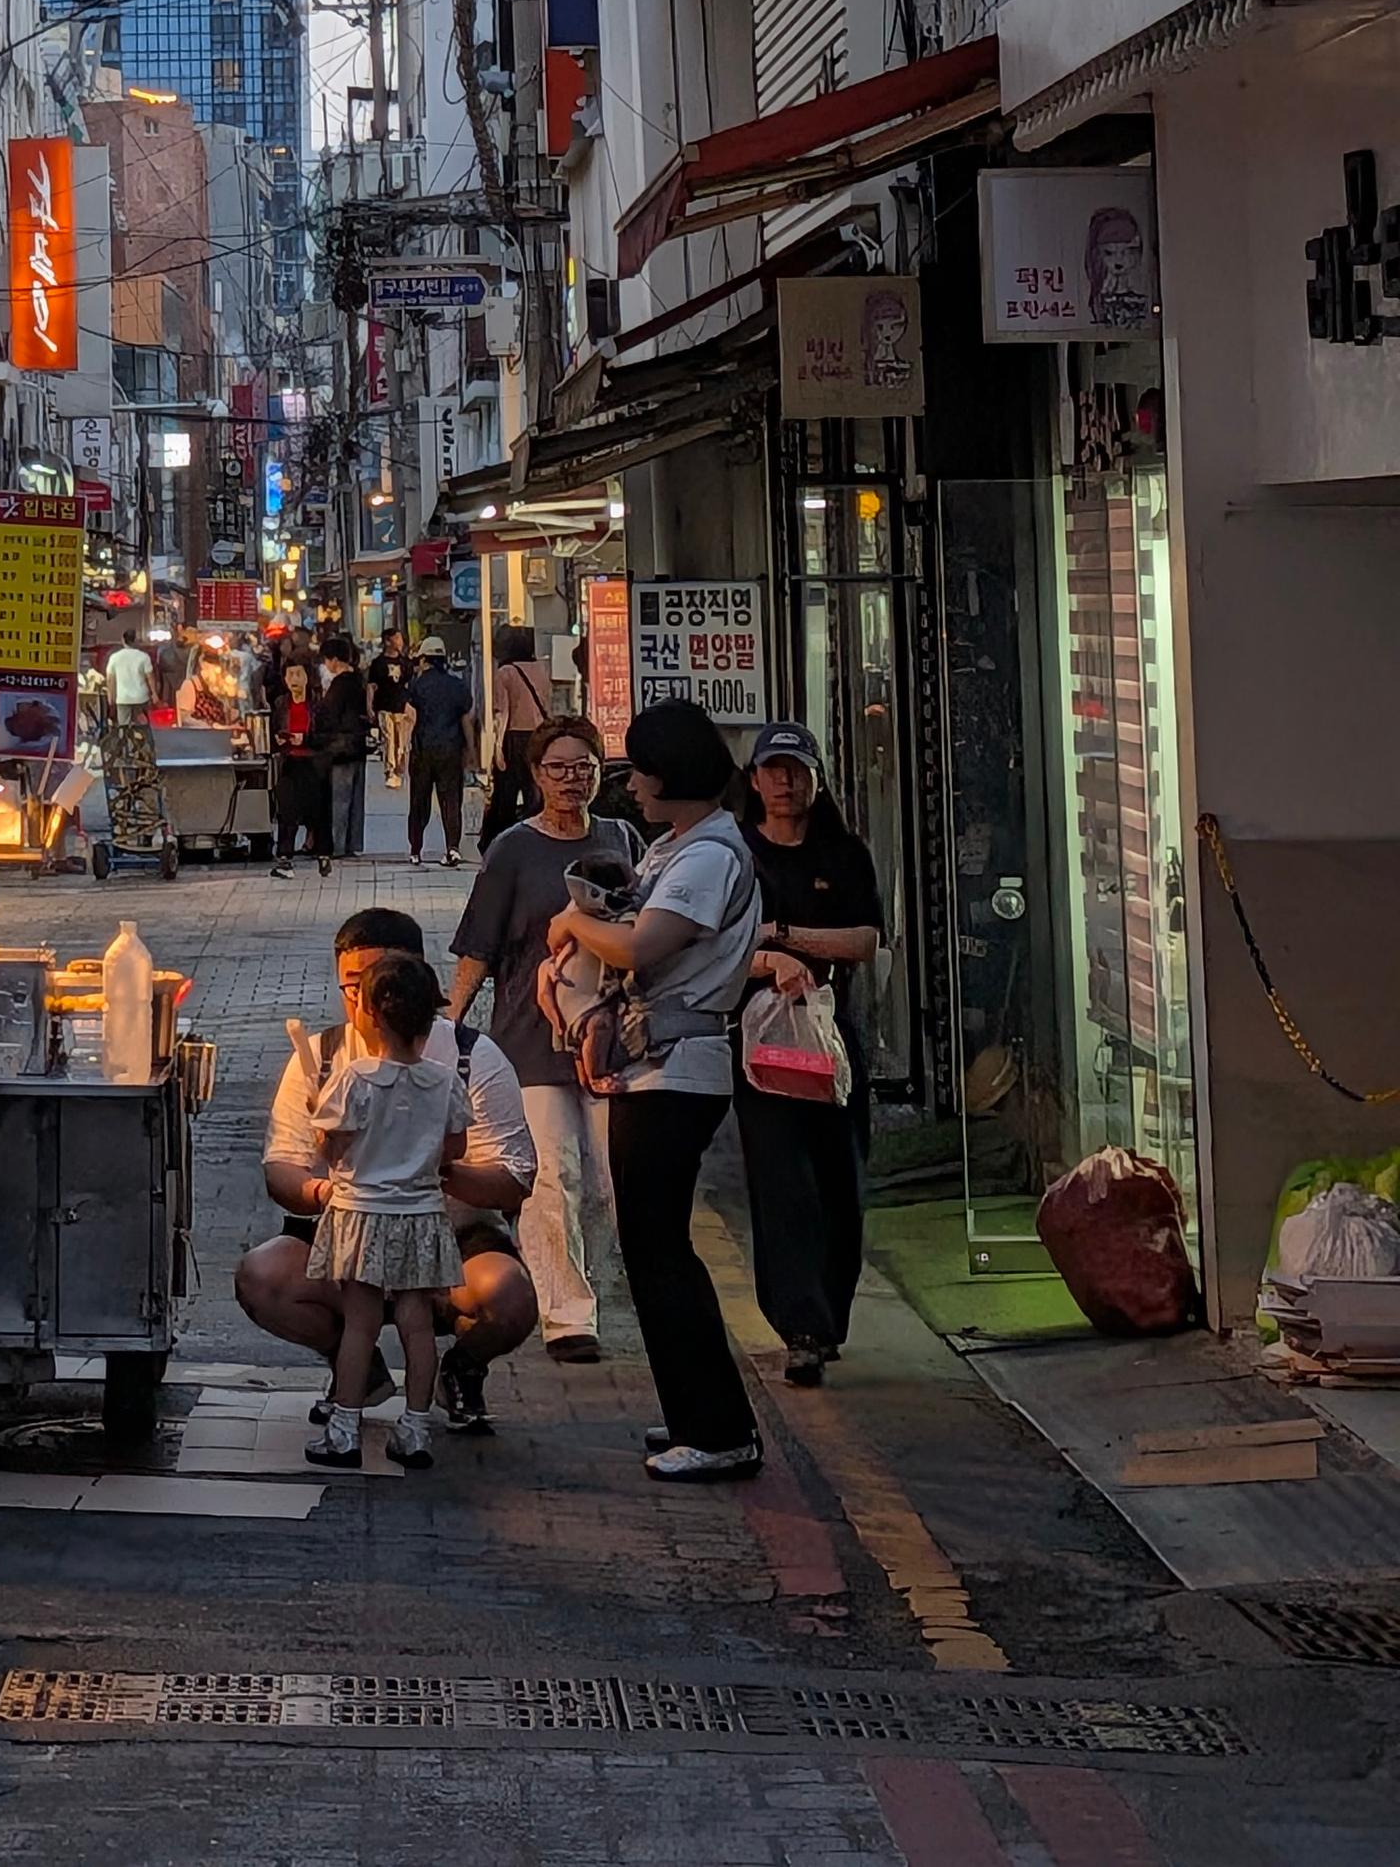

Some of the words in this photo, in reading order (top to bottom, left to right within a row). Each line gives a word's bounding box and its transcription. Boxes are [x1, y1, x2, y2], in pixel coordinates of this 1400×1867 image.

[1006, 300, 1077, 320] 프린세스
[664, 588, 753, 627] 공장직영
[639, 633, 681, 671] 국산
[688, 633, 756, 672] 면양말
